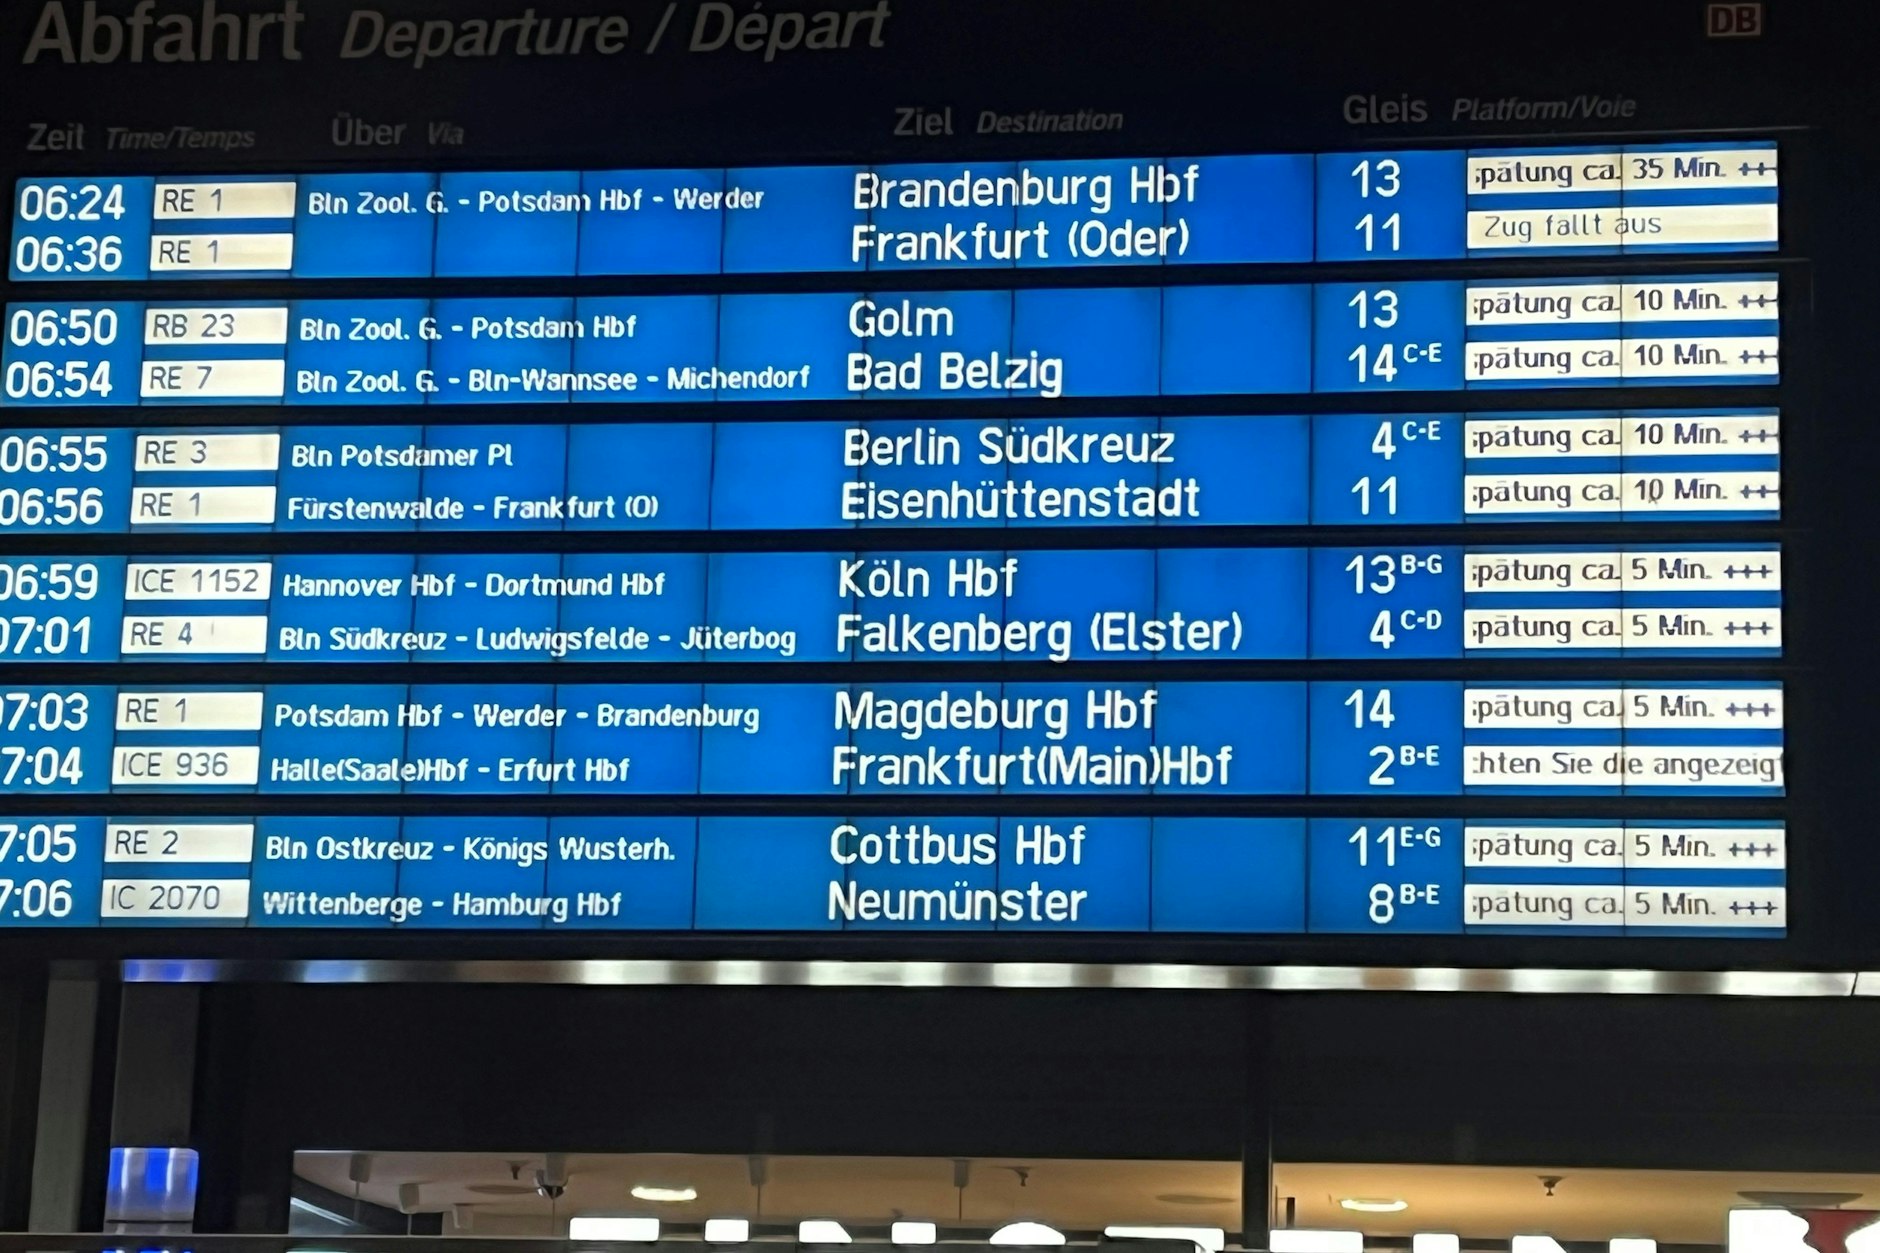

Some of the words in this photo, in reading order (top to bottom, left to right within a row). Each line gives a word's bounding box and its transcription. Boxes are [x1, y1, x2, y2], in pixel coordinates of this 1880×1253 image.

[22, 0, 304, 64] Abfahrt
[339, 9, 629, 69] Departure
[689, 1, 892, 62] Départ
[1711, 7, 1757, 34] DB
[894, 107, 954, 136] Ziel
[976, 110, 1123, 134] Destination
[1344, 93, 1428, 124] Gleis
[1452, 94, 1636, 121] Platform/Voie
[26, 122, 85, 152] Zeit
[106, 126, 256, 151] Time/Temps
[332, 111, 407, 146] Über
[428, 121, 465, 146] Via
[1351, 159, 1400, 198] 13
[1633, 158, 1664, 179] 35
[1674, 157, 1726, 179] Min.
[20, 183, 126, 221] 06:24
[162, 188, 196, 213] RE
[210, 188, 222, 212] 1
[308, 192, 349, 215] Bln
[356, 191, 417, 214] Zool.
[425, 191, 449, 214] G.
[478, 190, 591, 213] Potsdam
[600, 188, 643, 211] Hbf
[673, 187, 765, 210] Werder
[854, 168, 1112, 214] Brandenburg
[1130, 164, 1200, 204] Hbf
[852, 220, 1049, 263] Frankfurt
[1068, 218, 1189, 258] (Oder)
[1355, 212, 1400, 252] 11
[1484, 215, 1532, 243] Zug
[1614, 215, 1662, 234] aus
[15, 235, 123, 273] 06:36
[158, 239, 191, 264] RE
[207, 240, 218, 263] 1
[1348, 289, 1398, 329] 13
[1633, 289, 1663, 311] 10
[1673, 288, 1727, 310] Min.
[10, 308, 118, 347] 06:50
[153, 313, 188, 338] RB
[201, 313, 235, 338] 23
[300, 318, 341, 341] Bln
[348, 317, 410, 341] Zool.
[418, 317, 442, 341] G.
[471, 316, 585, 339] Potsdam
[593, 314, 637, 338] Hbf
[849, 299, 954, 338] Golm
[1633, 344, 1664, 366] 10
[1674, 343, 1727, 365] Min.
[5, 360, 113, 399] 06:54
[150, 365, 183, 390] RE
[197, 365, 212, 389] 7
[296, 370, 338, 394] Bln
[345, 370, 407, 393] Zool.
[415, 369, 440, 393] G.
[468, 368, 638, 392] Bln-Wannsee
[667, 365, 810, 390] Michendorf
[847, 352, 922, 391] Bad
[940, 350, 1063, 398] Belzig
[844, 427, 960, 467] Berlin
[978, 425, 1175, 465] Südkreuz
[1581, 427, 1622, 446] ca.
[1634, 423, 1664, 445] 10
[1674, 422, 1728, 445] Min.
[0, 435, 108, 473] 06:55
[144, 440, 178, 465] RE
[190, 440, 207, 464] 3
[291, 444, 333, 468] Bln
[341, 444, 479, 467] Potsdamer
[488, 443, 513, 466] Pl
[140, 492, 173, 517] RE
[189, 492, 200, 516] 1
[841, 478, 1200, 520] Eisenhüttenstadt
[1351, 476, 1397, 515] 11
[1581, 483, 1622, 503] ca.
[1634, 478, 1664, 504] 10
[1674, 478, 1728, 500] Min.
[0, 487, 104, 526] 06:56
[288, 496, 464, 520] Fürstenwalde
[493, 495, 615, 519] Frankfurt
[625, 495, 659, 518] (O)
[0, 563, 99, 601] 06:59
[134, 568, 176, 593] ICE
[191, 568, 259, 592] 1152
[839, 559, 930, 598] Köln
[948, 558, 1018, 597] Hbf
[1581, 562, 1622, 582] ca.
[1632, 557, 1648, 580] 5
[1658, 557, 1712, 580] Min.
[283, 574, 403, 597] Hannover
[410, 573, 456, 597] Hbf
[485, 573, 613, 597] Dortmund
[621, 572, 666, 596] Hbf
[130, 621, 164, 646] RE
[178, 622, 193, 645] 4
[837, 613, 1072, 661] Falkenberg
[1090, 611, 1242, 652] (Elster)
[1581, 618, 1622, 637] ca.
[1632, 614, 1648, 637] 5
[1659, 614, 1713, 636] Min.
[279, 627, 321, 651] Bln
[329, 627, 447, 651] Südkreuz
[476, 626, 650, 657] Ludwigsfelde
[680, 626, 796, 657] Jüterbog
[125, 698, 160, 723] RE
[175, 698, 186, 722] 1
[274, 703, 389, 727] Potsdam
[397, 703, 443, 727] Hbf
[473, 703, 567, 727] Werder
[597, 703, 760, 734] Brandenburg
[834, 690, 1069, 740] Magdeburg
[1086, 689, 1158, 729] Hbf
[1344, 688, 1395, 729] 14
[1583, 699, 1625, 718] ca.
[1634, 695, 1649, 717] 5
[1660, 695, 1714, 717] Min.
[121, 752, 162, 777] ICE
[176, 752, 228, 777] 936
[271, 758, 469, 782] Halle(Saale)Hbf
[498, 757, 576, 782] Erfurt
[585, 757, 630, 782] Hbf
[832, 745, 1233, 785] Frankfurt(Main)Hbf
[1552, 752, 1593, 774] Sie
[1603, 751, 1644, 775] die
[114, 829, 149, 855] RE
[161, 830, 179, 855] 2
[266, 835, 308, 860] Bln
[316, 836, 434, 861] Ostkreuz
[463, 836, 548, 868] Königs
[559, 836, 675, 861] Wusterh.
[830, 824, 997, 865] Cottbus
[1016, 824, 1086, 865] Hbf
[1584, 838, 1624, 857] ca.
[1635, 834, 1651, 857] 5
[1661, 834, 1716, 857] Min.
[110, 884, 136, 910] IC
[148, 885, 220, 910] 2070
[263, 891, 423, 923] Wittenberge
[453, 892, 568, 923] Hamburg
[577, 892, 622, 916] Hbf
[828, 880, 1088, 922] Neumünster
[1584, 898, 1625, 917] ca.
[1635, 892, 1651, 915] 5
[1662, 892, 1716, 916] Min.
